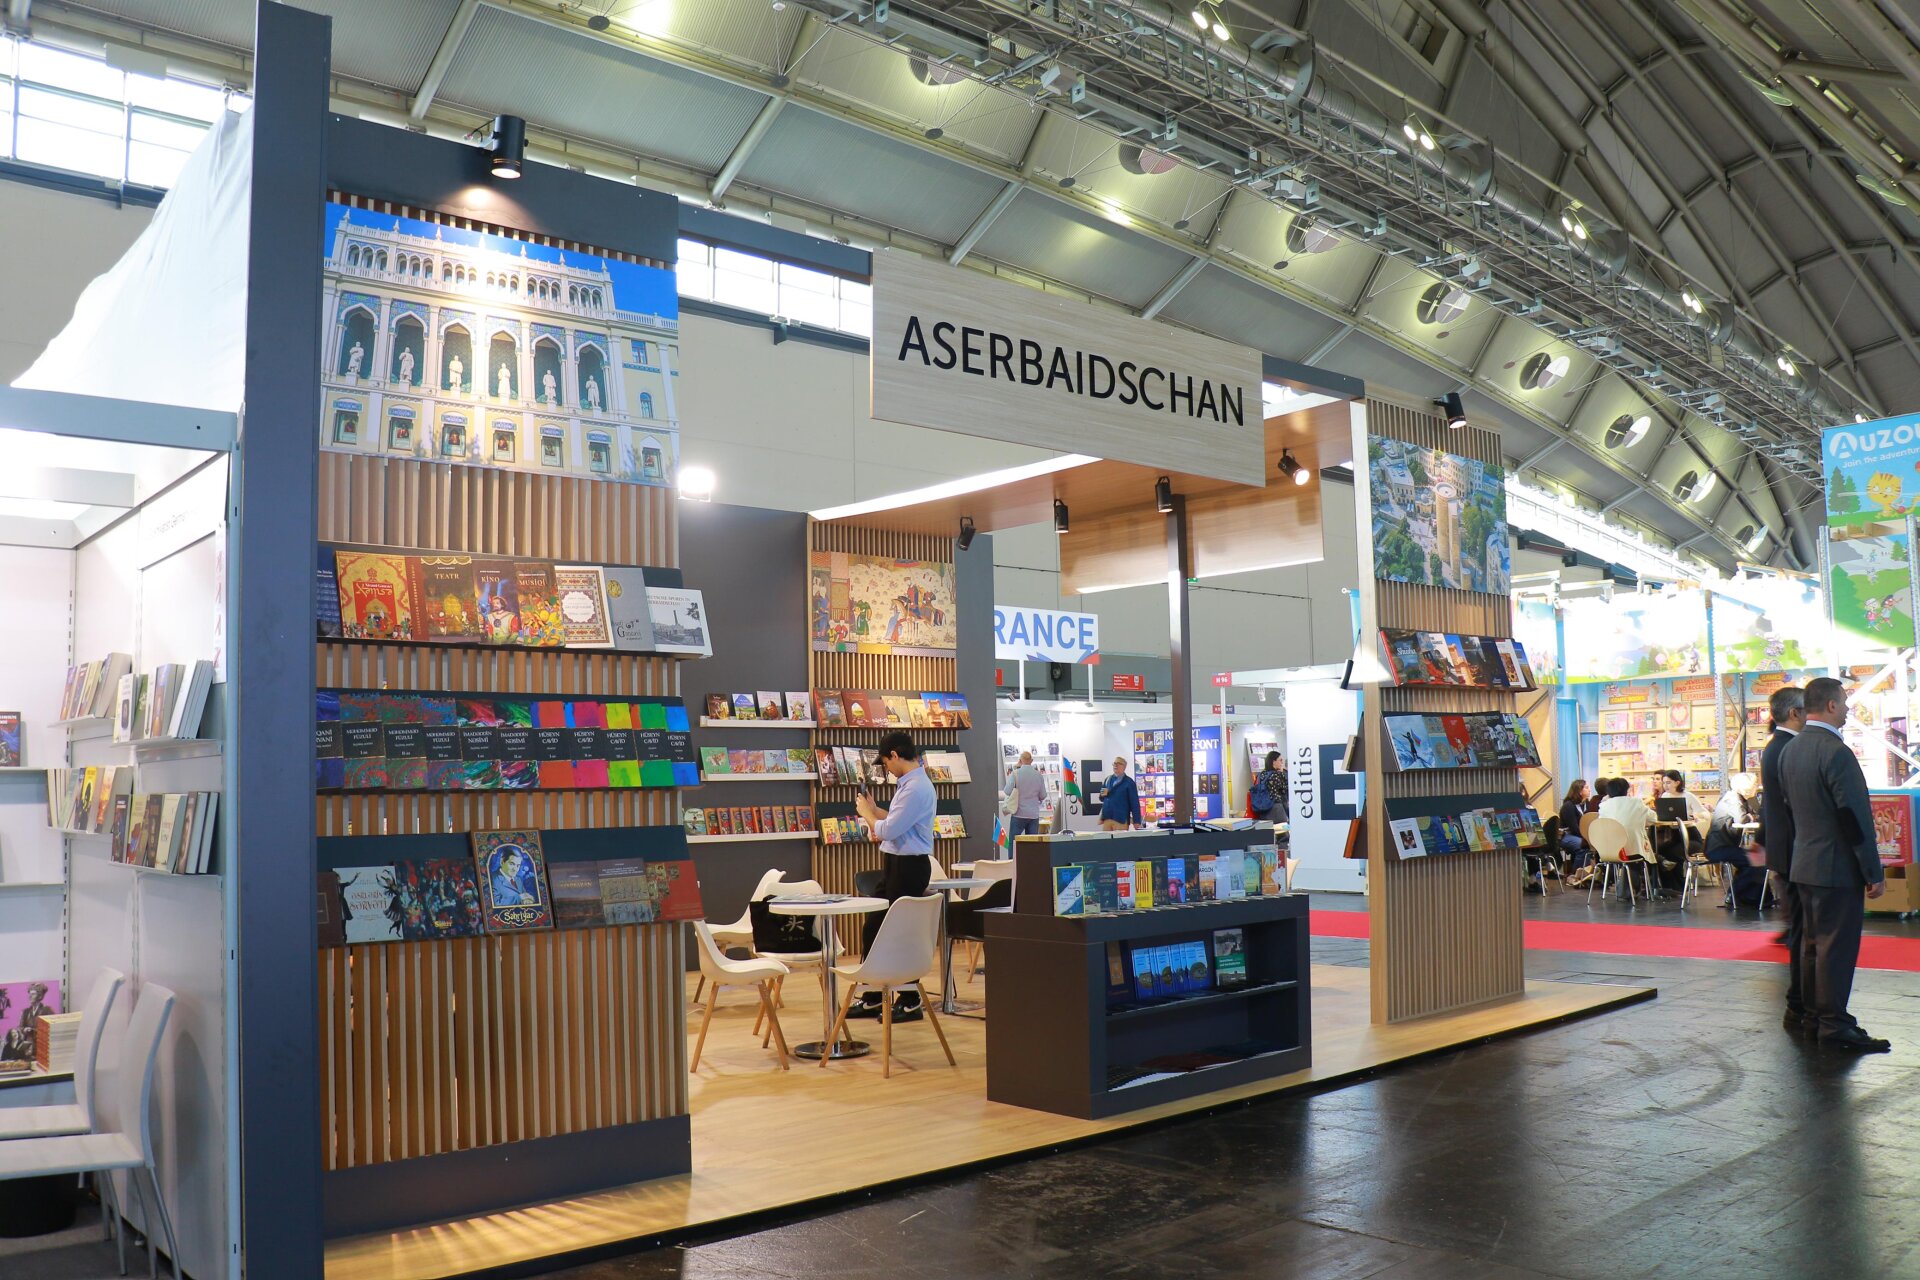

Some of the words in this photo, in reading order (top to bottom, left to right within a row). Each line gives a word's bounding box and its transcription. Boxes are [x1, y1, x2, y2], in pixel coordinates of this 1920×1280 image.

[898, 315, 1244, 427] ASERBAIDSCHAN
[1864, 455, 1878, 463] the
[1880, 447, 1920, 461] adventur
[1081, 759, 1103, 816] E
[1293, 746, 1314, 819] editis
[1318, 743, 1357, 821] E
